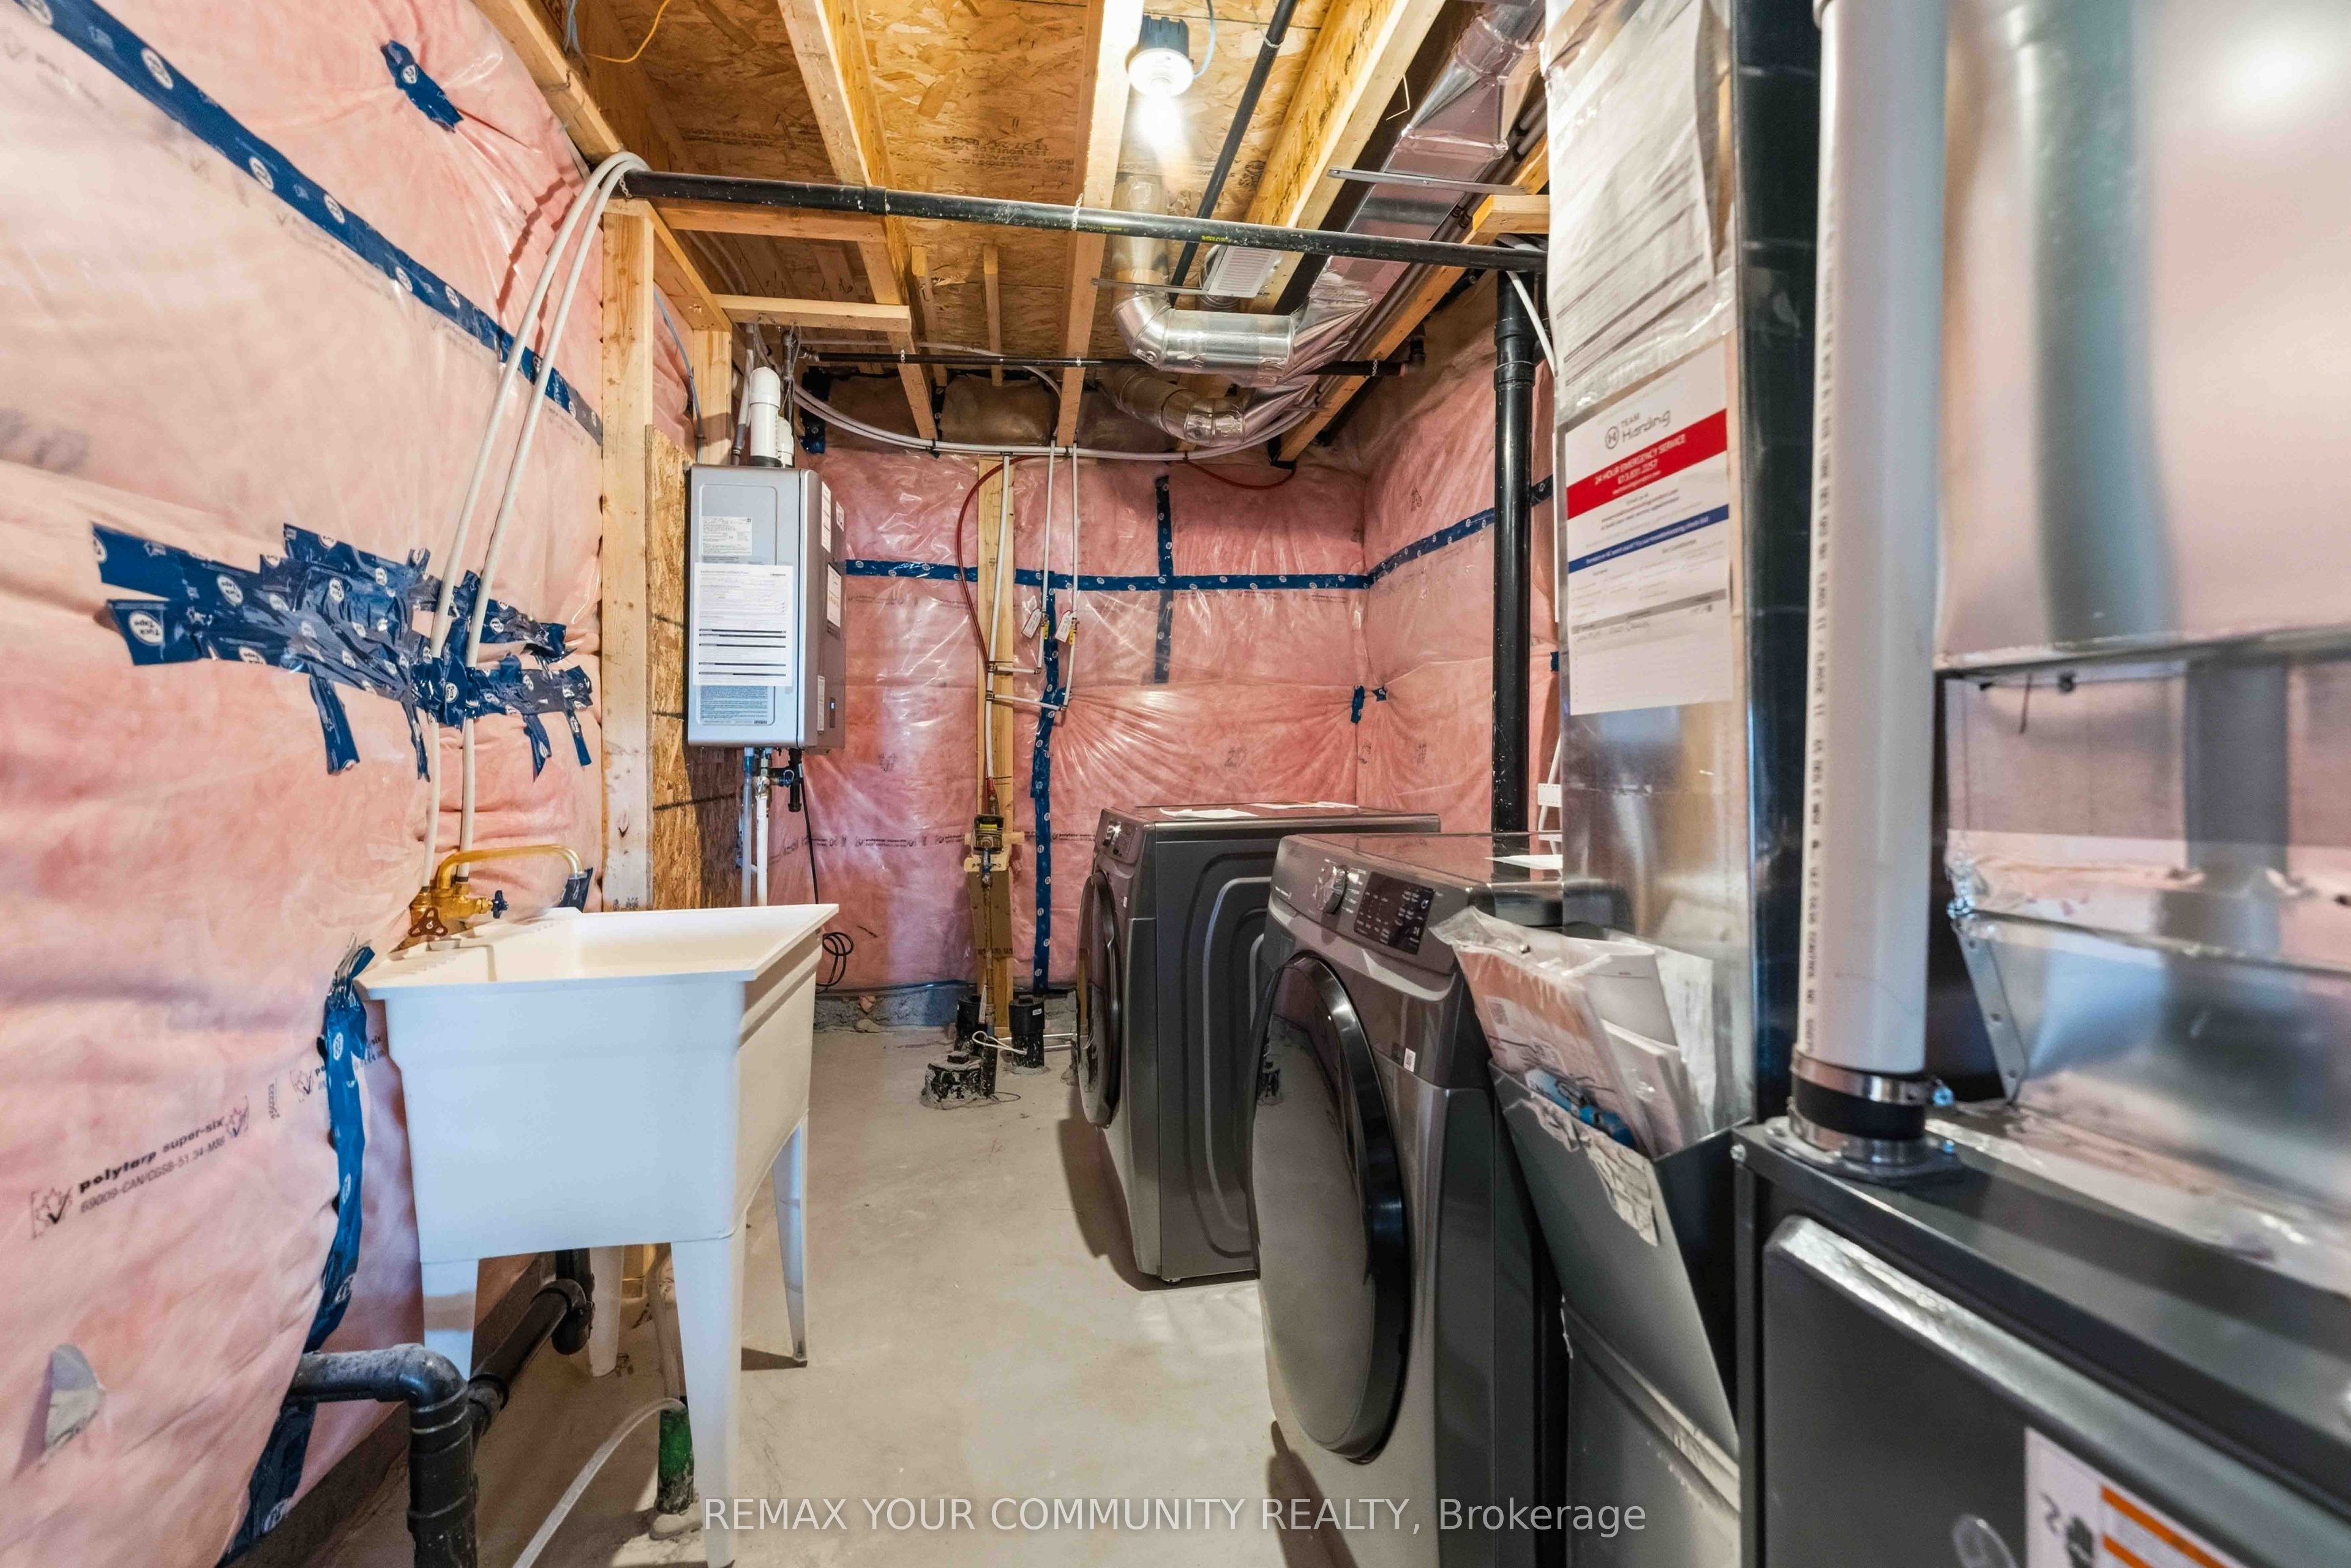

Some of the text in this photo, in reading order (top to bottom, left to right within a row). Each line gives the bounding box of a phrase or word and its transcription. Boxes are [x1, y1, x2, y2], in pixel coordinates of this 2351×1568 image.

[1622, 410, 1671, 442] Harding
[134, 620, 154, 628] Tape
[139, 628, 160, 637] Tuck
[79, 1116, 225, 1193] polytarp super-six
